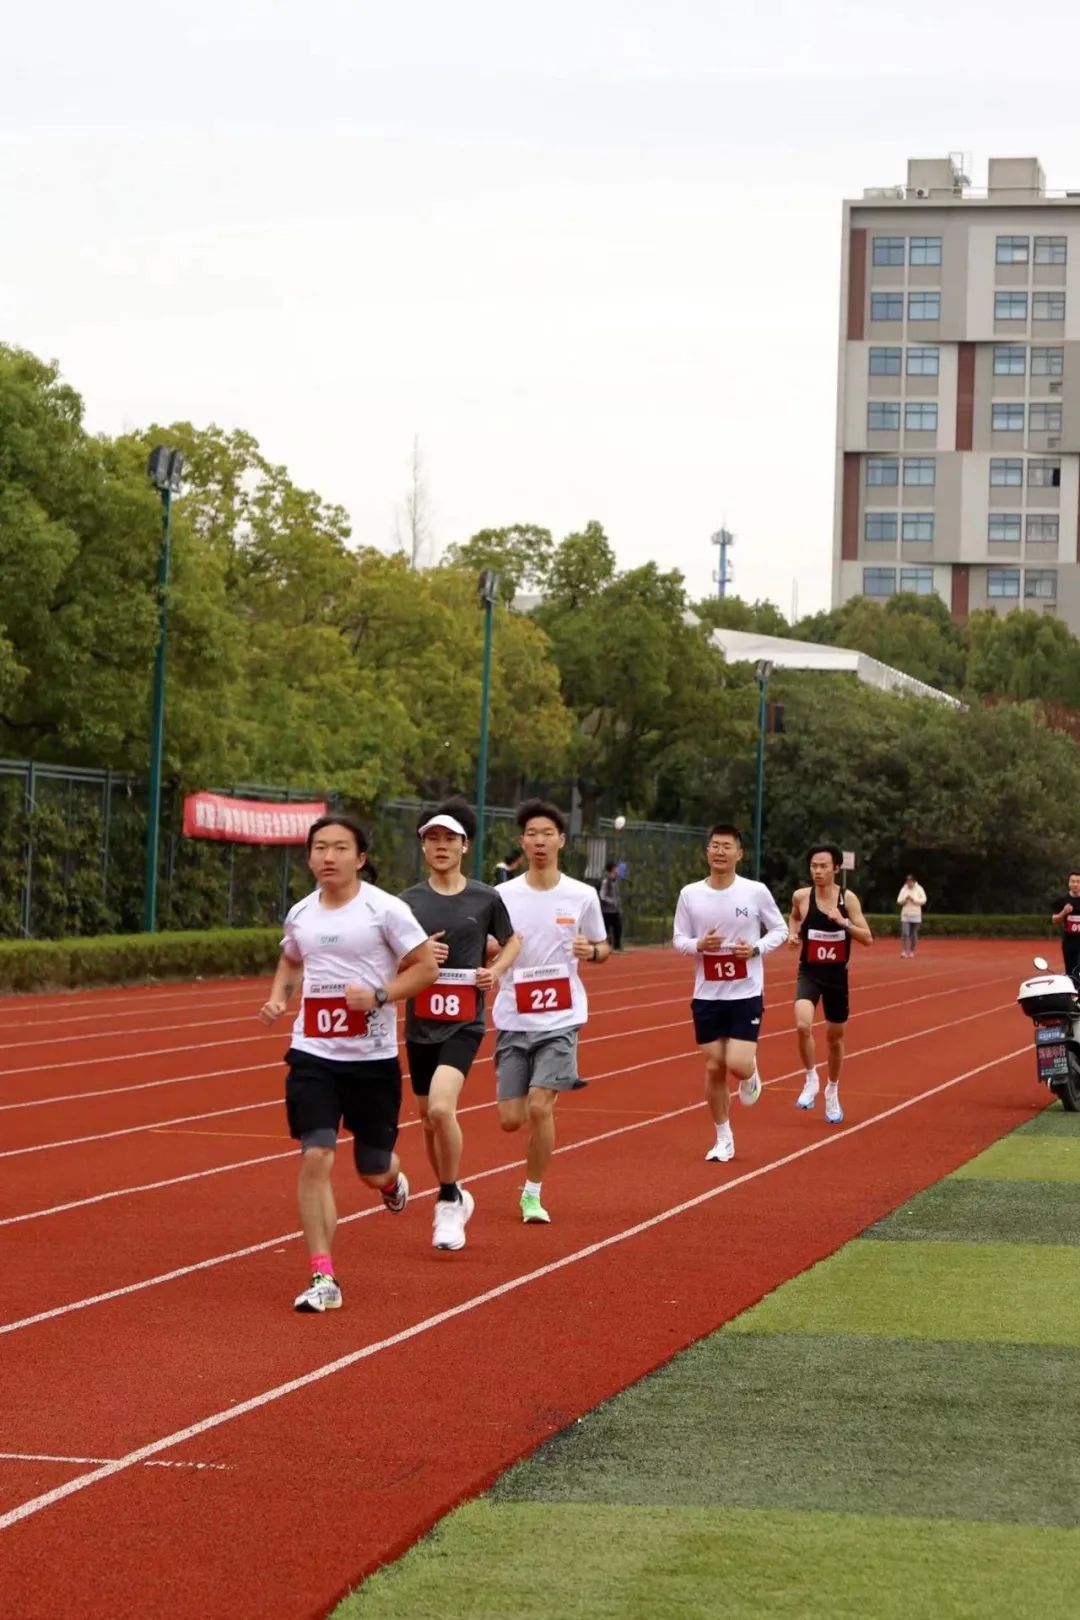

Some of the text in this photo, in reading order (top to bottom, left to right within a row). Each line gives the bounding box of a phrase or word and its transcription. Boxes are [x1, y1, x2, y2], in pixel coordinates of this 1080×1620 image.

[817, 946, 837, 960] 04
[714, 961, 736, 977] 13
[430, 993, 460, 1016] 08
[530, 987, 558, 1009] 22
[317, 1008, 348, 1033] 02
